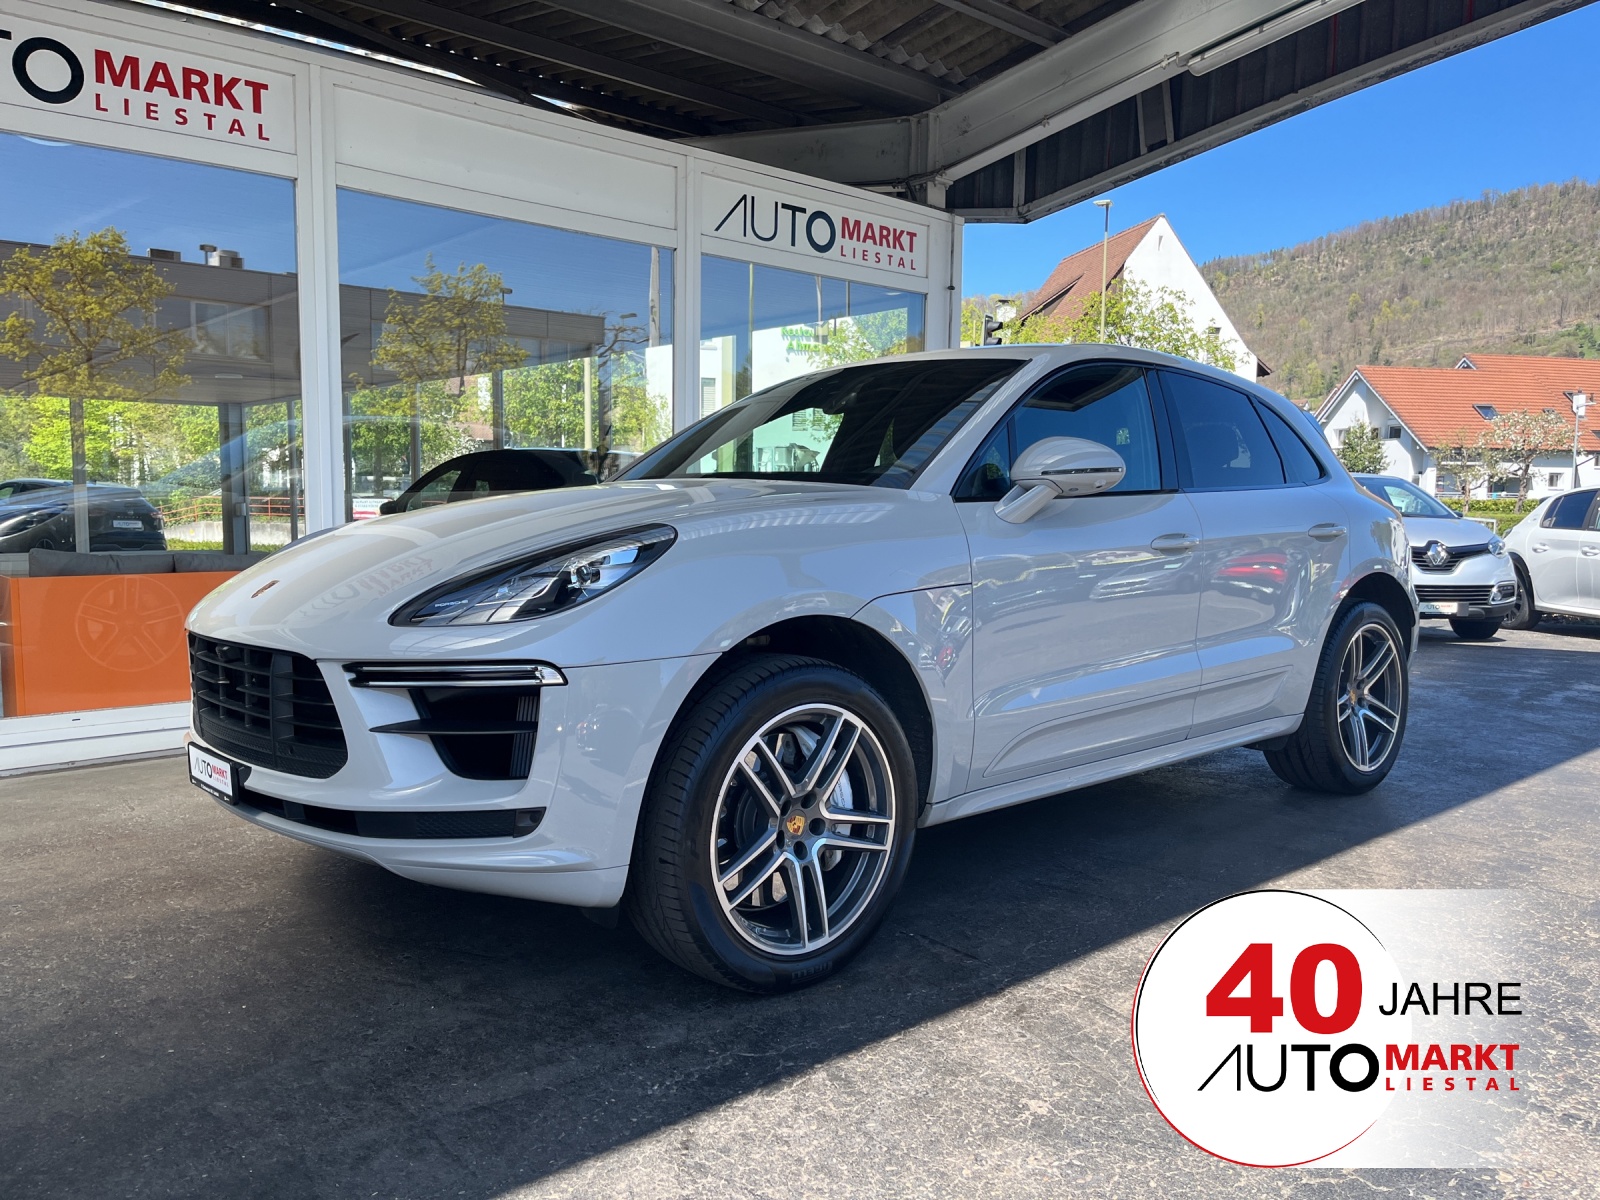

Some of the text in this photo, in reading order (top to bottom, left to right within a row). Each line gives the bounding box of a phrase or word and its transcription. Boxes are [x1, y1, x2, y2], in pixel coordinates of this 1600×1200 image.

[94, 48, 269, 115] MARKT
[95, 93, 270, 142] LIESTAL
[714, 193, 918, 254] AUTO MARKT
[840, 245, 917, 271] LIESTAL
[194, 757, 228, 780] AUTO MARKT
